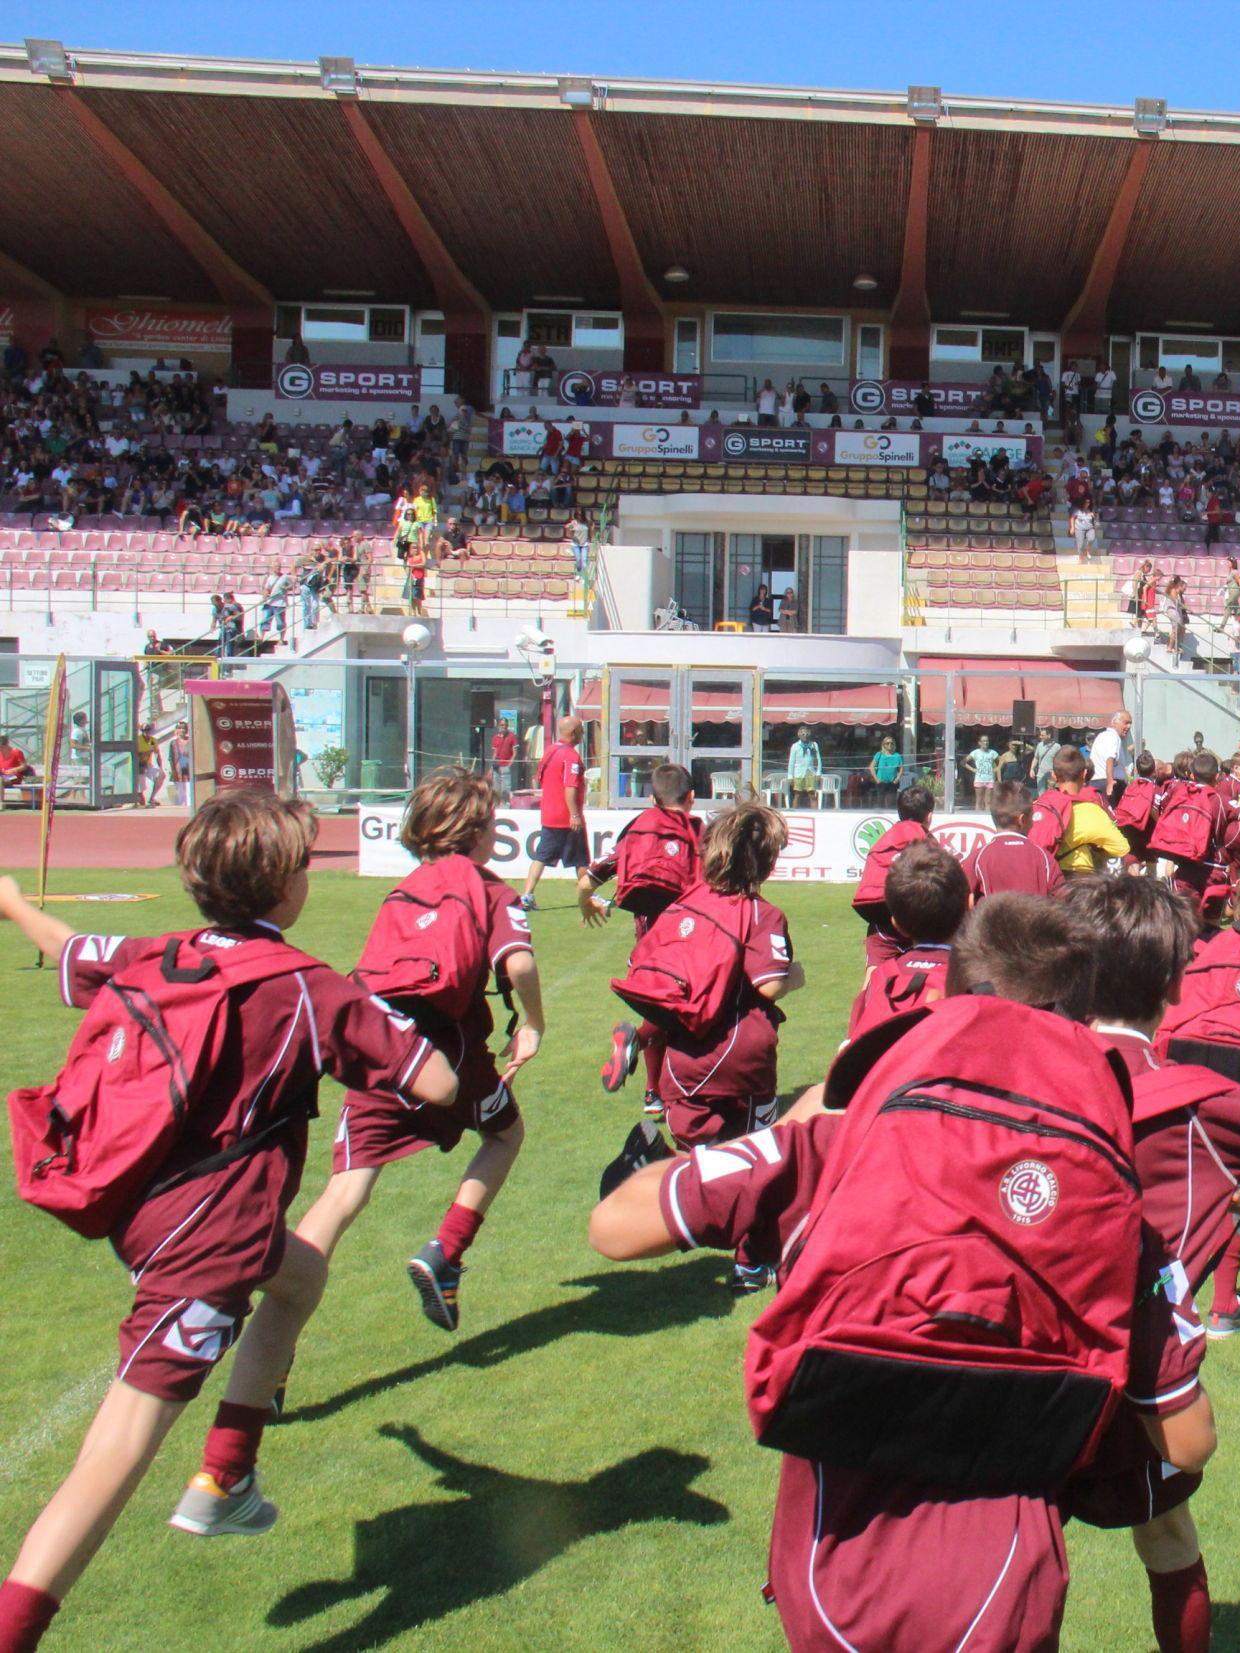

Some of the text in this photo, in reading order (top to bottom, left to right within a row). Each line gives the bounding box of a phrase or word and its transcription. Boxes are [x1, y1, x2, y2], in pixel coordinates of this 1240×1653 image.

[89, 311, 232, 336] Ghiomell
[283, 371, 413, 392] G SPORT
[601, 378, 693, 394] SORT
[320, 387, 360, 395] marketing
[369, 388, 413, 396] sponsoring
[856, 387, 881, 407] G
[1136, 397, 1161, 417] G
[1171, 412, 1209, 420] marketing
[750, 438, 806, 448] SPORT
[238, 768, 274, 776] SPOR
[940, 832, 988, 853] KIA
[769, 866, 832, 878] EAT
[1011, 1161, 1047, 1176] LIVORNO
[1046, 1171, 1058, 1207] CALCIO
